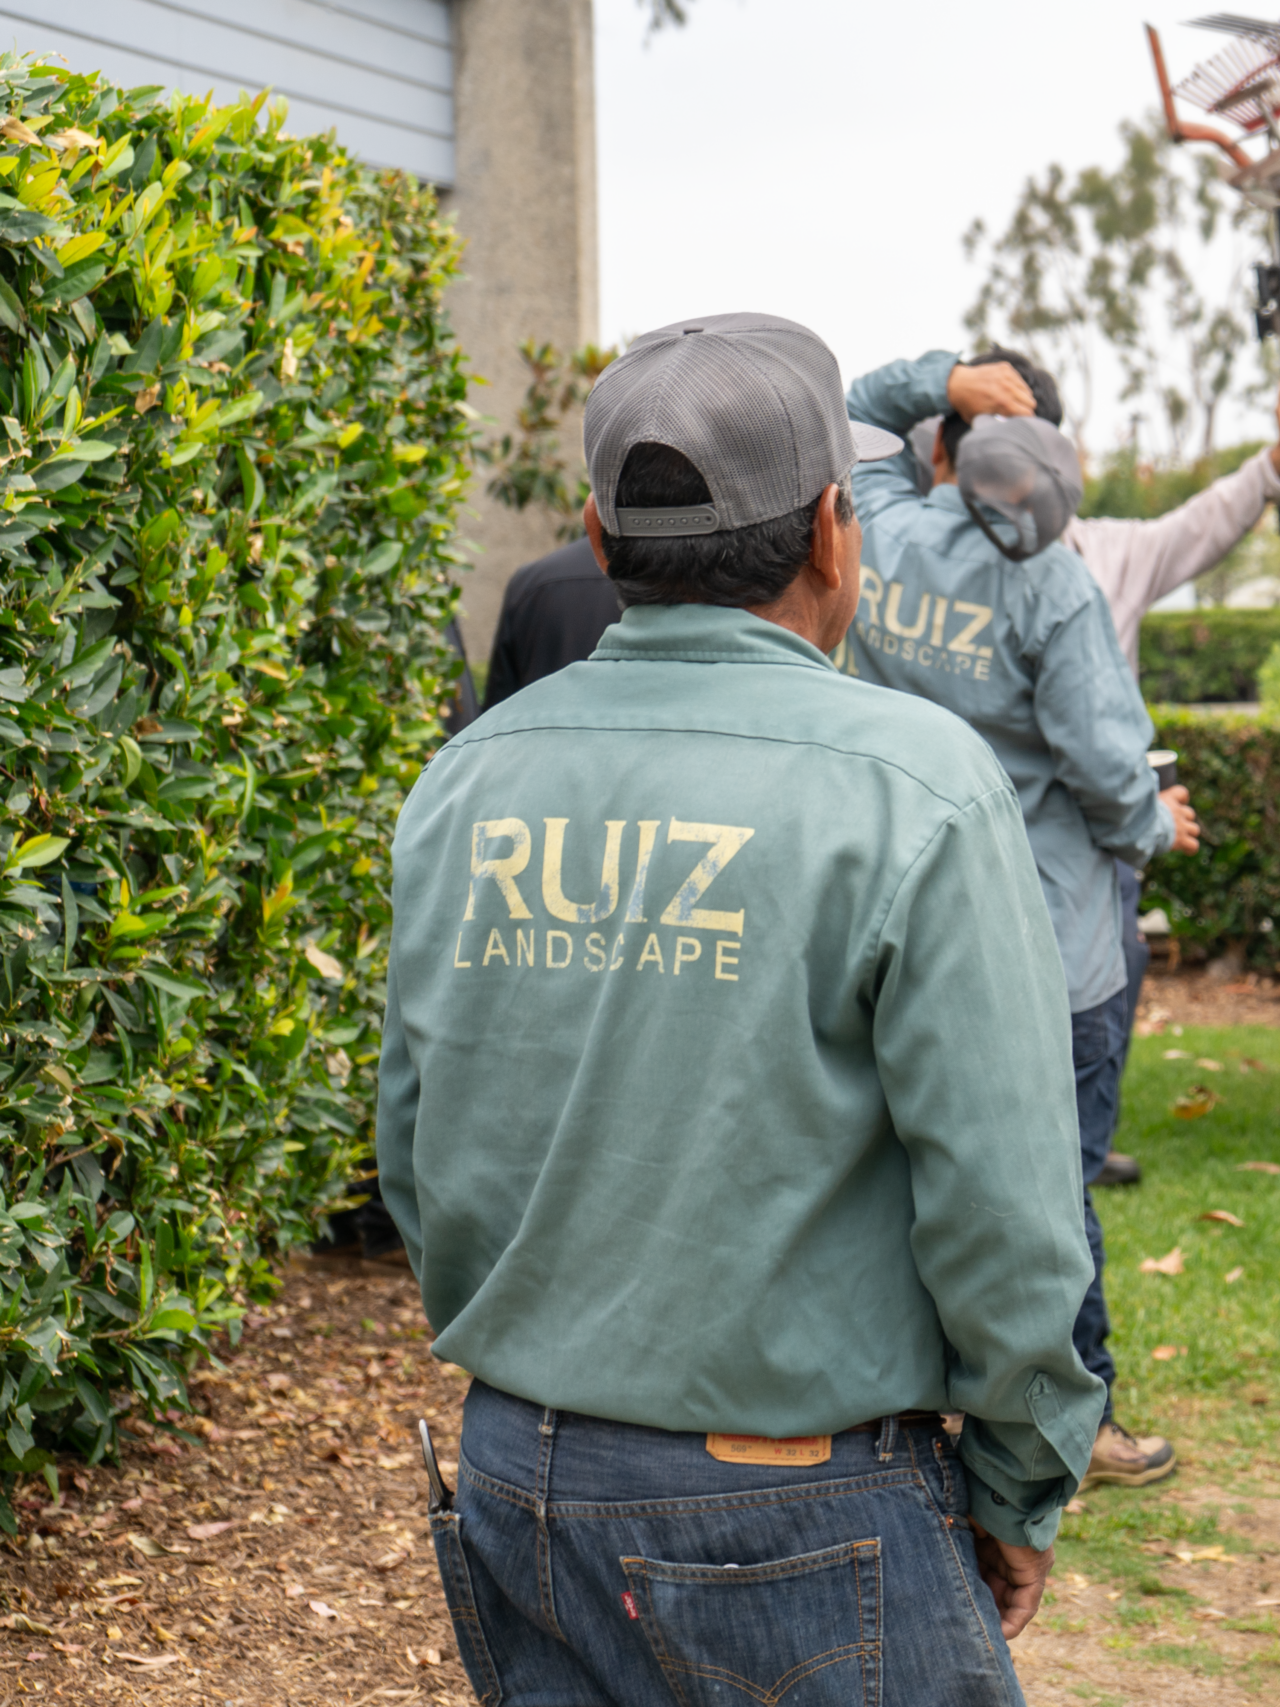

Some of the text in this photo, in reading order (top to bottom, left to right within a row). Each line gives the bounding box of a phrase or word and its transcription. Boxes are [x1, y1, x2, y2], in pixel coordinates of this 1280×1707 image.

[856, 620, 992, 681] ANDSCAPE
[859, 564, 994, 659] RUIZ
[463, 816, 755, 937] RUIZ
[454, 928, 741, 981] LANDSCAPE
